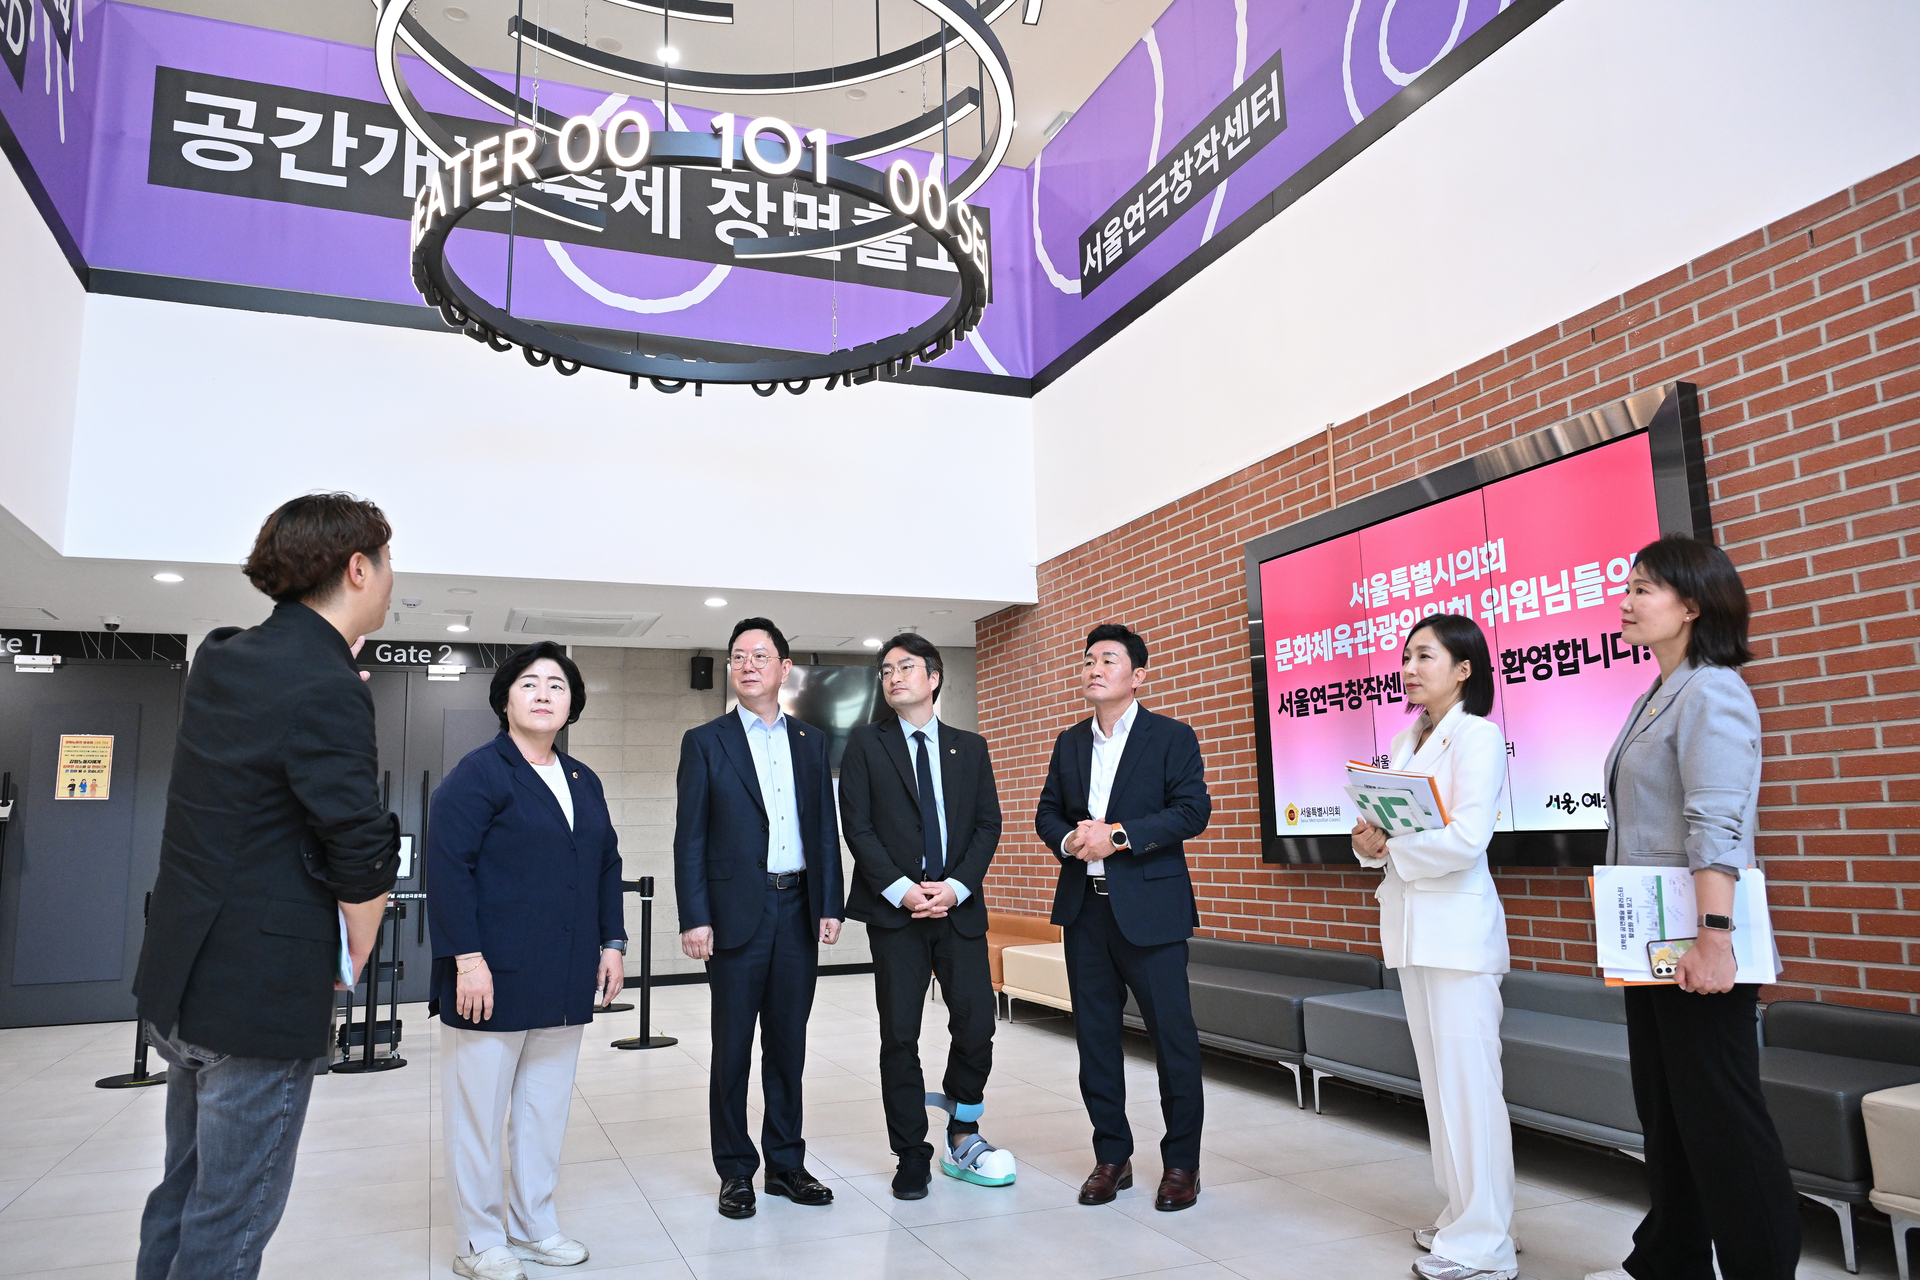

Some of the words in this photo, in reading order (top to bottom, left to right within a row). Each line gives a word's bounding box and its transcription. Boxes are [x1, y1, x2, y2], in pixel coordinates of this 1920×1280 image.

[710, 112, 828, 185] 101
[1082, 69, 1281, 276] 서울연극창작센터
[1349, 538, 1507, 609] 서울특별시의회
[1480, 552, 1638, 627] 위원님들의
[32, 633, 42, 654] 1
[375, 643, 432, 663] Gate
[438, 644, 453, 664] 2
[1277, 671, 1407, 718] 서울연극창작센
[1300, 806, 1340, 817] 서울특별시의회
[1626, 897, 1633, 908] 보고
[1627, 909, 1634, 921] 계획
